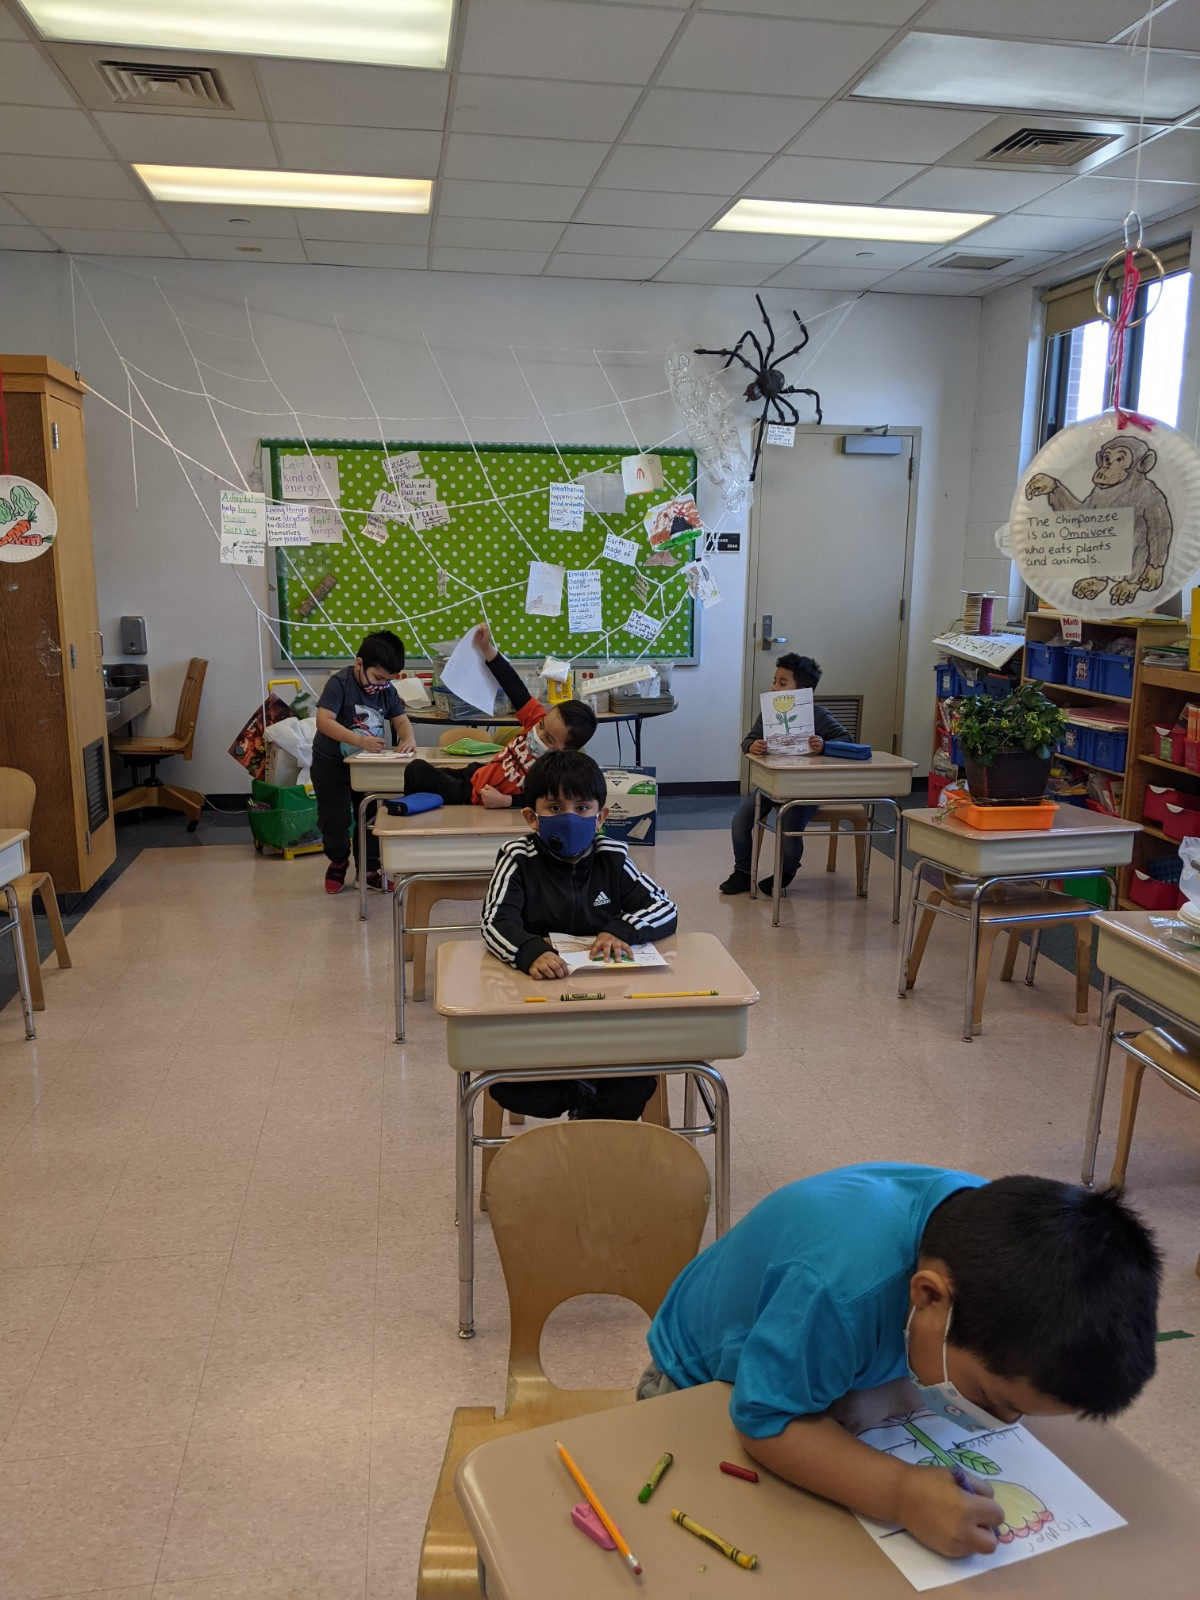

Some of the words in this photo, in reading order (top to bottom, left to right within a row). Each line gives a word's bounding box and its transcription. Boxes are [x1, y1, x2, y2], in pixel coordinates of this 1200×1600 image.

[324, 461, 333, 471] a
[383, 457, 411, 471] Frces
[306, 470, 318, 482] of
[400, 480, 417, 489] Push
[418, 481, 431, 489] and
[284, 484, 321, 498] energy
[221, 503, 237, 514] help
[1026, 516, 1050, 527] The
[1027, 530, 1038, 540] is
[1041, 531, 1055, 539] an
[1060, 526, 1116, 540] Omnivore
[607, 534, 626, 548] Earth
[1025, 545, 1045, 554] who
[1048, 543, 1072, 555] eats
[1076, 540, 1111, 556] plants
[1026, 555, 1047, 566] and
[1063, 618, 1080, 626] Math
